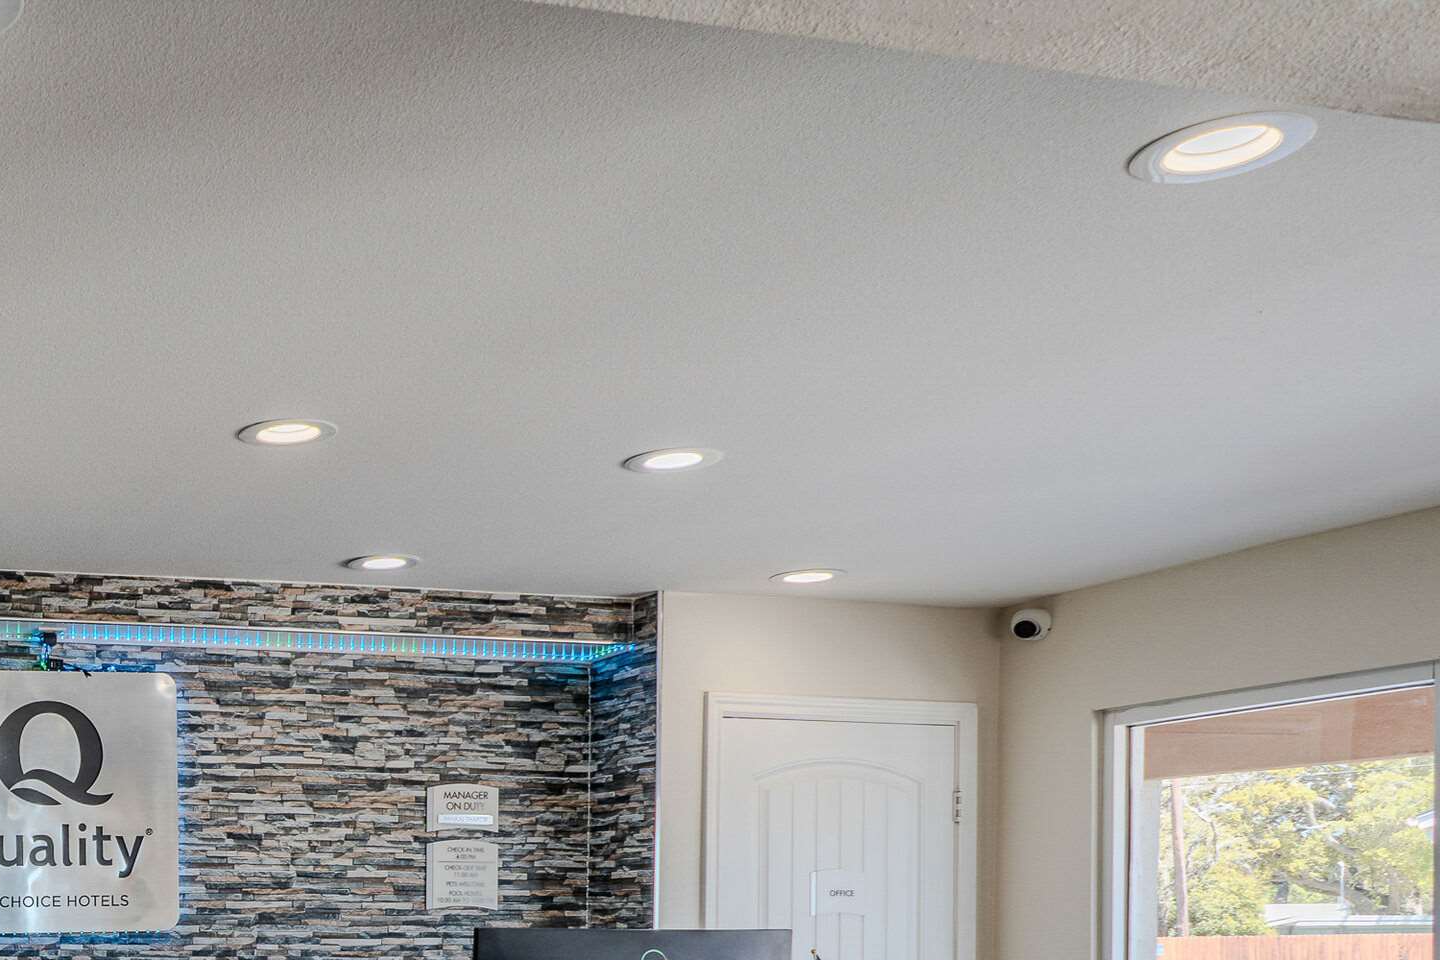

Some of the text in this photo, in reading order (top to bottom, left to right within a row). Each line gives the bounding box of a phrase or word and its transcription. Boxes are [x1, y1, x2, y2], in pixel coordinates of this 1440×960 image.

[443, 791, 489, 800] MANAGER
[446, 801, 462, 811] ON
[829, 889, 856, 897] OFFICE
[0, 895, 61, 908] CHOICE
[67, 894, 129, 907] HOTELS
